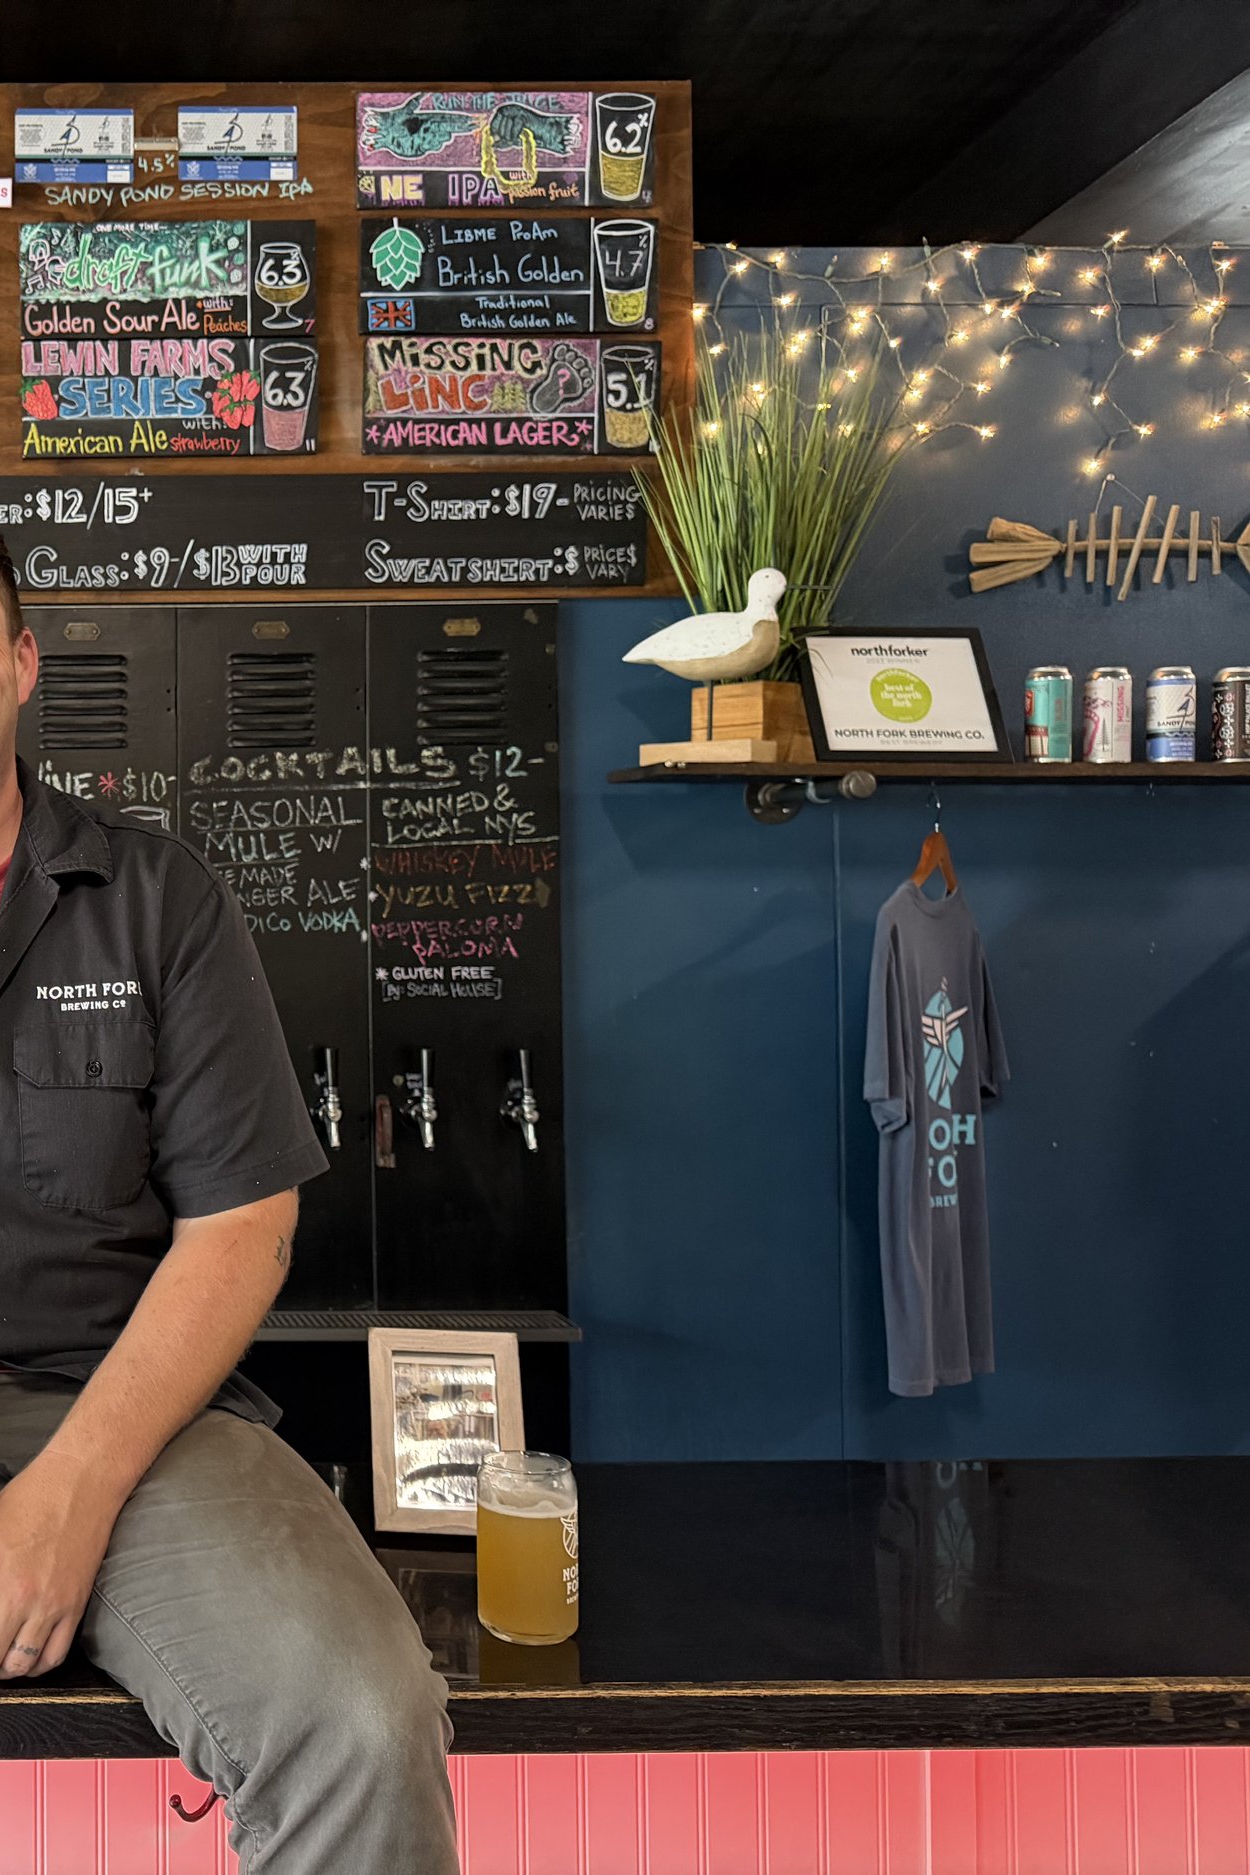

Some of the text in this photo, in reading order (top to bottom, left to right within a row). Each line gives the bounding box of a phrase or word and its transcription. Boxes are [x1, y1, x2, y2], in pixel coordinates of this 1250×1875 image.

[45, 177, 313, 207] SANDY POND SESSION IPA
[381, 173, 502, 201] NE IPA
[63, 232, 229, 295] draft funk
[437, 253, 584, 287] British Golden
[475, 294, 550, 309] Traditional
[24, 300, 200, 336] Golden Sour Ale
[203, 313, 247, 336] Peaches
[460, 312, 576, 329] British Golden Ale
[22, 340, 236, 378] LEWIN FARMS
[377, 339, 546, 376] MISSING
[59, 377, 206, 419] SERIES
[378, 373, 490, 414] LINC
[23, 421, 167, 457] American Ale
[170, 432, 241, 454] strawberry
[382, 421, 580, 447] AMERICAN LAGER
[573, 480, 641, 503] PRICING
[576, 501, 635, 521] VARIES
[238, 544, 307, 563] WITH
[242, 564, 306, 585] POUR
[586, 563, 629, 583] VARY
[851, 645, 928, 657] northforker
[835, 729, 984, 740] NORTH FORK BREWING CO.
[188, 746, 456, 787] COCKTAILS
[190, 795, 363, 830] SEASONAL
[382, 783, 519, 819] CANNED &
[387, 811, 536, 845] LOCAL NYS
[204, 832, 301, 863] MULE
[374, 844, 557, 878] WHISKEY MULE
[307, 878, 360, 907] ALE
[375, 884, 459, 918] YUZU
[298, 908, 361, 933] VODKA
[413, 936, 519, 965] PALOMA
[392, 966, 495, 980] GLUTEN FREE
[37, 984, 97, 999] NORTH
[61, 1001, 109, 1011] BREWING
